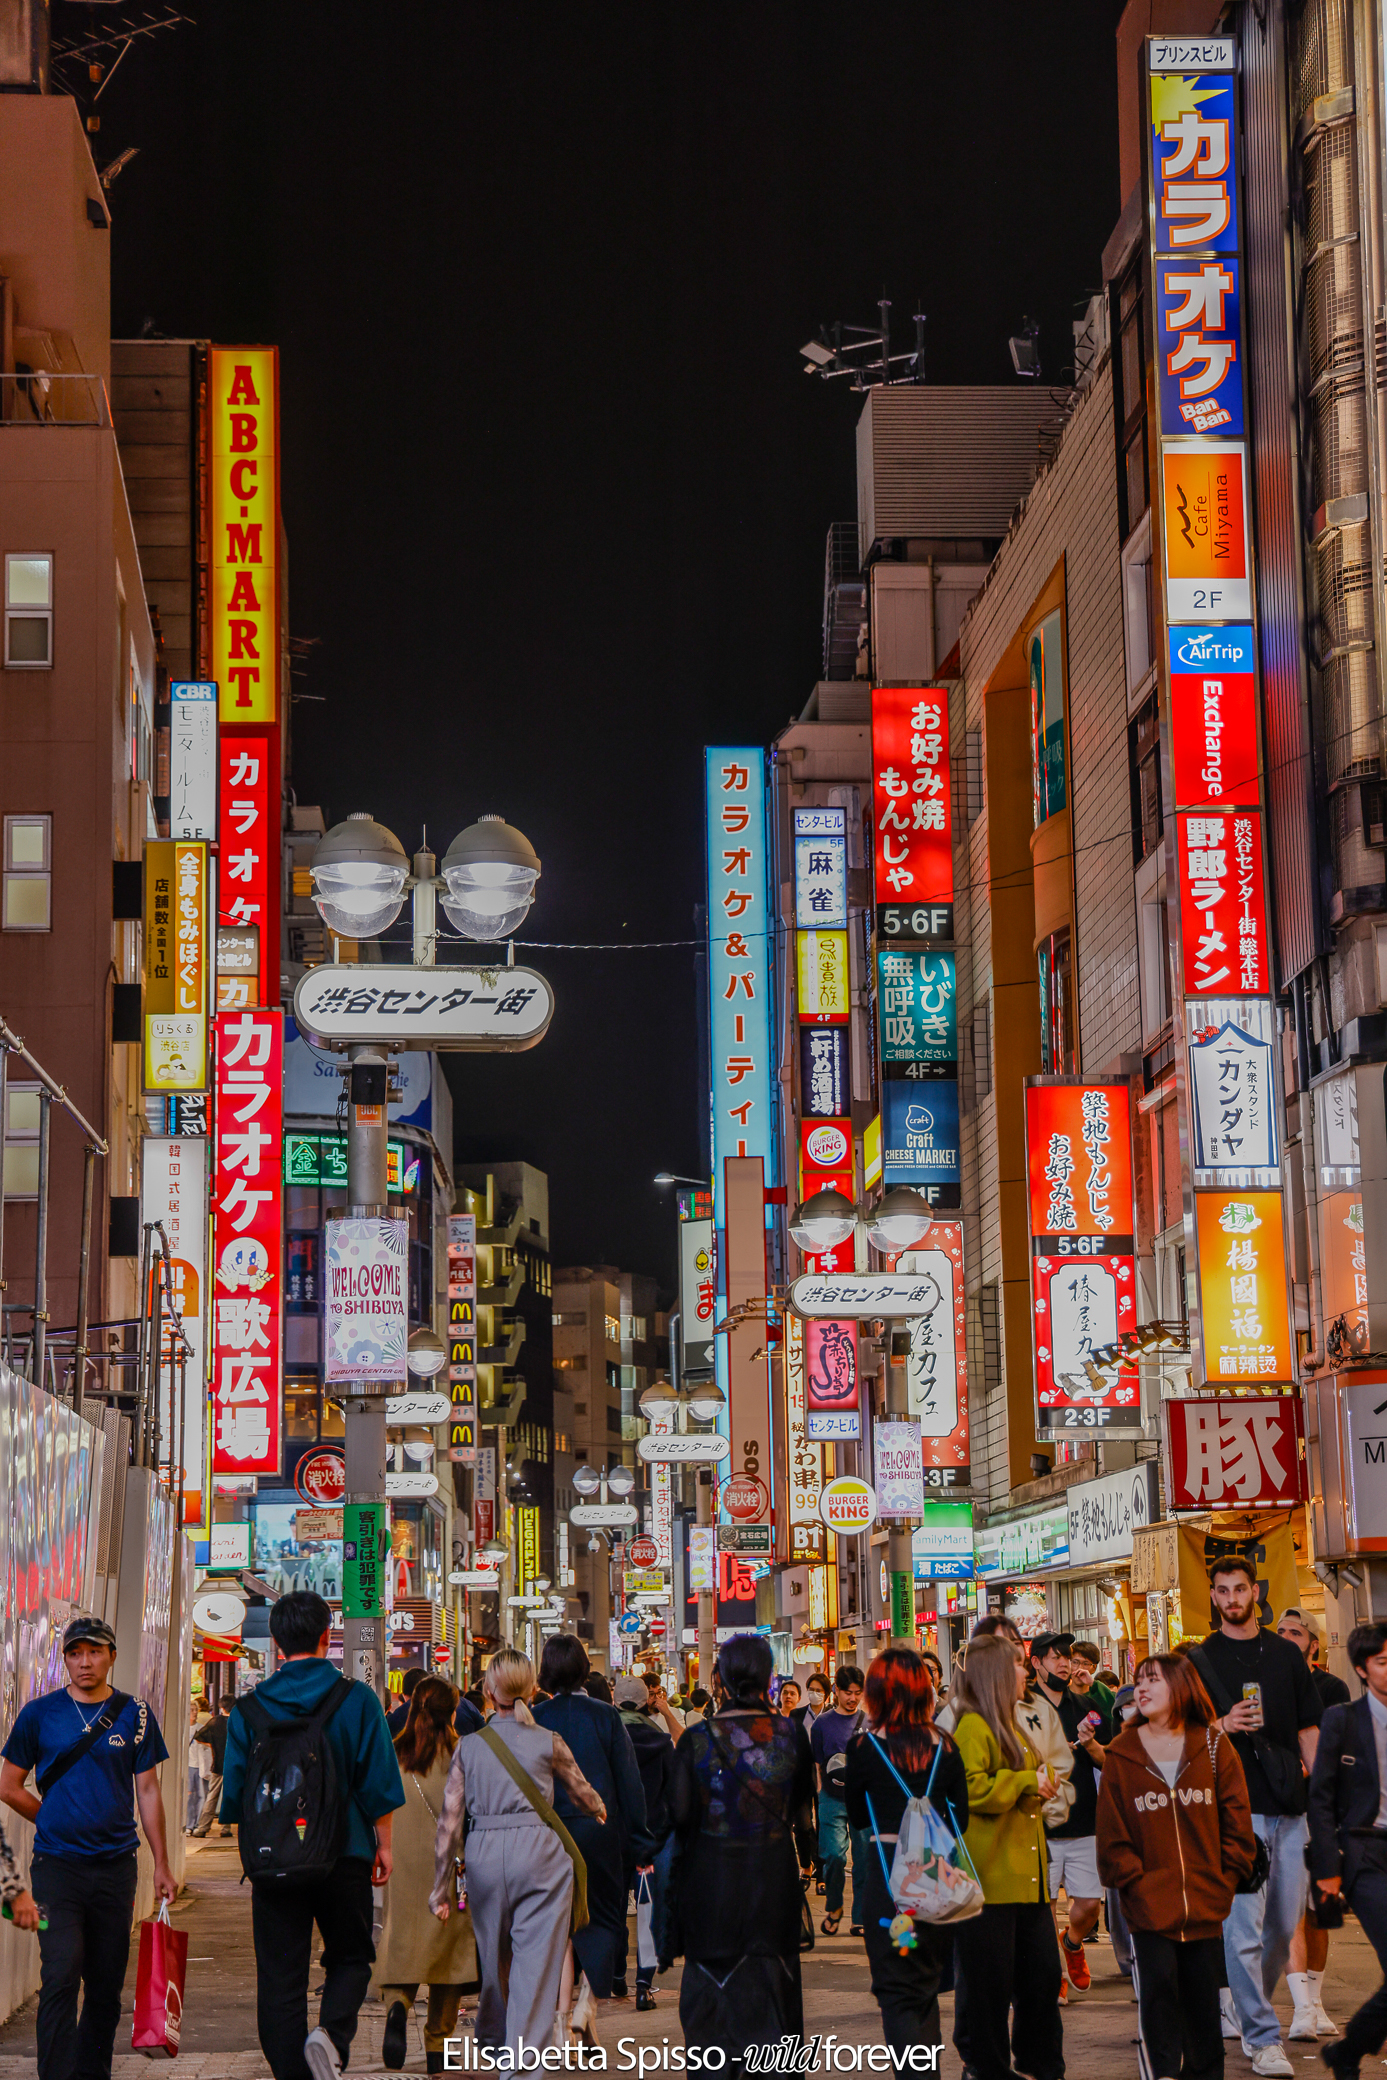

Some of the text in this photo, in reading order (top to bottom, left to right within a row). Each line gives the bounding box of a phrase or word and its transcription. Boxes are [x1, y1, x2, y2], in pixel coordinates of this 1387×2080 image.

[1156, 45, 1227, 63] プリンスビル
[1161, 111, 1236, 399] カラオケ
[1179, 398, 1220, 422] Ban
[1192, 409, 1232, 433] Ban
[1195, 496, 1209, 537] Cafe
[1214, 473, 1233, 559] Miyama
[226, 365, 262, 708] ABC-MART
[1193, 590, 1223, 608] 2F
[1189, 645, 1243, 662] AirTrip
[175, 685, 212, 699] CBR
[1202, 679, 1225, 798] Exchange
[176, 705, 194, 821] モニタールーム
[910, 701, 946, 831] お好み焼
[183, 828, 203, 839] 5F
[796, 816, 843, 829] センタービル
[879, 766, 914, 892] もんじゃ
[228, 752, 260, 925] カラオケ
[830, 839, 844, 848] 5F
[808, 851, 833, 911] 麻雀
[1186, 818, 1230, 990] 野郎ラーメン
[1234, 818, 1259, 990] 渋谷センター街 総本店
[154, 878, 169, 979] 店舗数全国1位
[179, 852, 200, 1009] 全身もみほぐし
[720, 762, 756, 1157] カラオケ&パーティー
[309, 987, 538, 1015] 渋谷センター街
[883, 956, 916, 1046] 無呼吸
[920, 956, 952, 1045] いびき
[155, 1023, 194, 1035] りらくる
[817, 1014, 831, 1022] 4F
[160, 1040, 190, 1052] 渋谷店
[886, 1049, 952, 1059] ご相談ください
[811, 1030, 834, 1115] 一軒め酒場
[905, 1062, 930, 1079] 4F
[1246, 1059, 1259, 1130] 大衆スタンド
[361, 1104, 379, 1115] JBL
[909, 1115, 930, 1124] craft
[1218, 1059, 1244, 1156] カンダヤ
[813, 1134, 840, 1147] BURGER
[814, 1142, 842, 1156] KING
[906, 1133, 934, 1148] Craft
[292, 1144, 347, 1175] 金ち
[885, 1150, 956, 1164] CHEESE MARKET
[1082, 1091, 1114, 1230] 築地もんじゃ
[1047, 1123, 1076, 1229] お好み焼
[168, 1145, 182, 1250] 韓国式居酒屋
[217, 1013, 274, 1461] カラオケ歌広場
[332, 1265, 400, 1297] WELCOME
[801, 1286, 931, 1302] 渋谷センター街
[330, 1300, 404, 1315] TO SHIBUYA
[1068, 1274, 1098, 1356] 椿屋カ
[1220, 1345, 1274, 1353] マーラータン
[912, 1312, 942, 1415] 屋カフェ
[809, 1418, 858, 1433] センタービル
[644, 1443, 724, 1453] 渋谷センター街
[880, 1450, 920, 1469] WELCOME
[1184, 1401, 1288, 1501] 豚
[308, 1469, 345, 1488] 消火栓
[726, 1491, 758, 1507] 消火栓
[795, 1493, 817, 1509] 99
[828, 1496, 869, 1505] BURGER
[829, 1505, 869, 1519] KING
[1081, 1491, 1131, 1548] 築地もんじゃ
[740, 1531, 768, 1539] 宝石広場
[1070, 1510, 1079, 1540] 5F
[794, 1526, 819, 1549] B1
[359, 1510, 376, 1610] 客引きは犯罪です
[632, 1548, 656, 1559] 消火栓
[918, 1562, 960, 1575] 酒 たばこ
